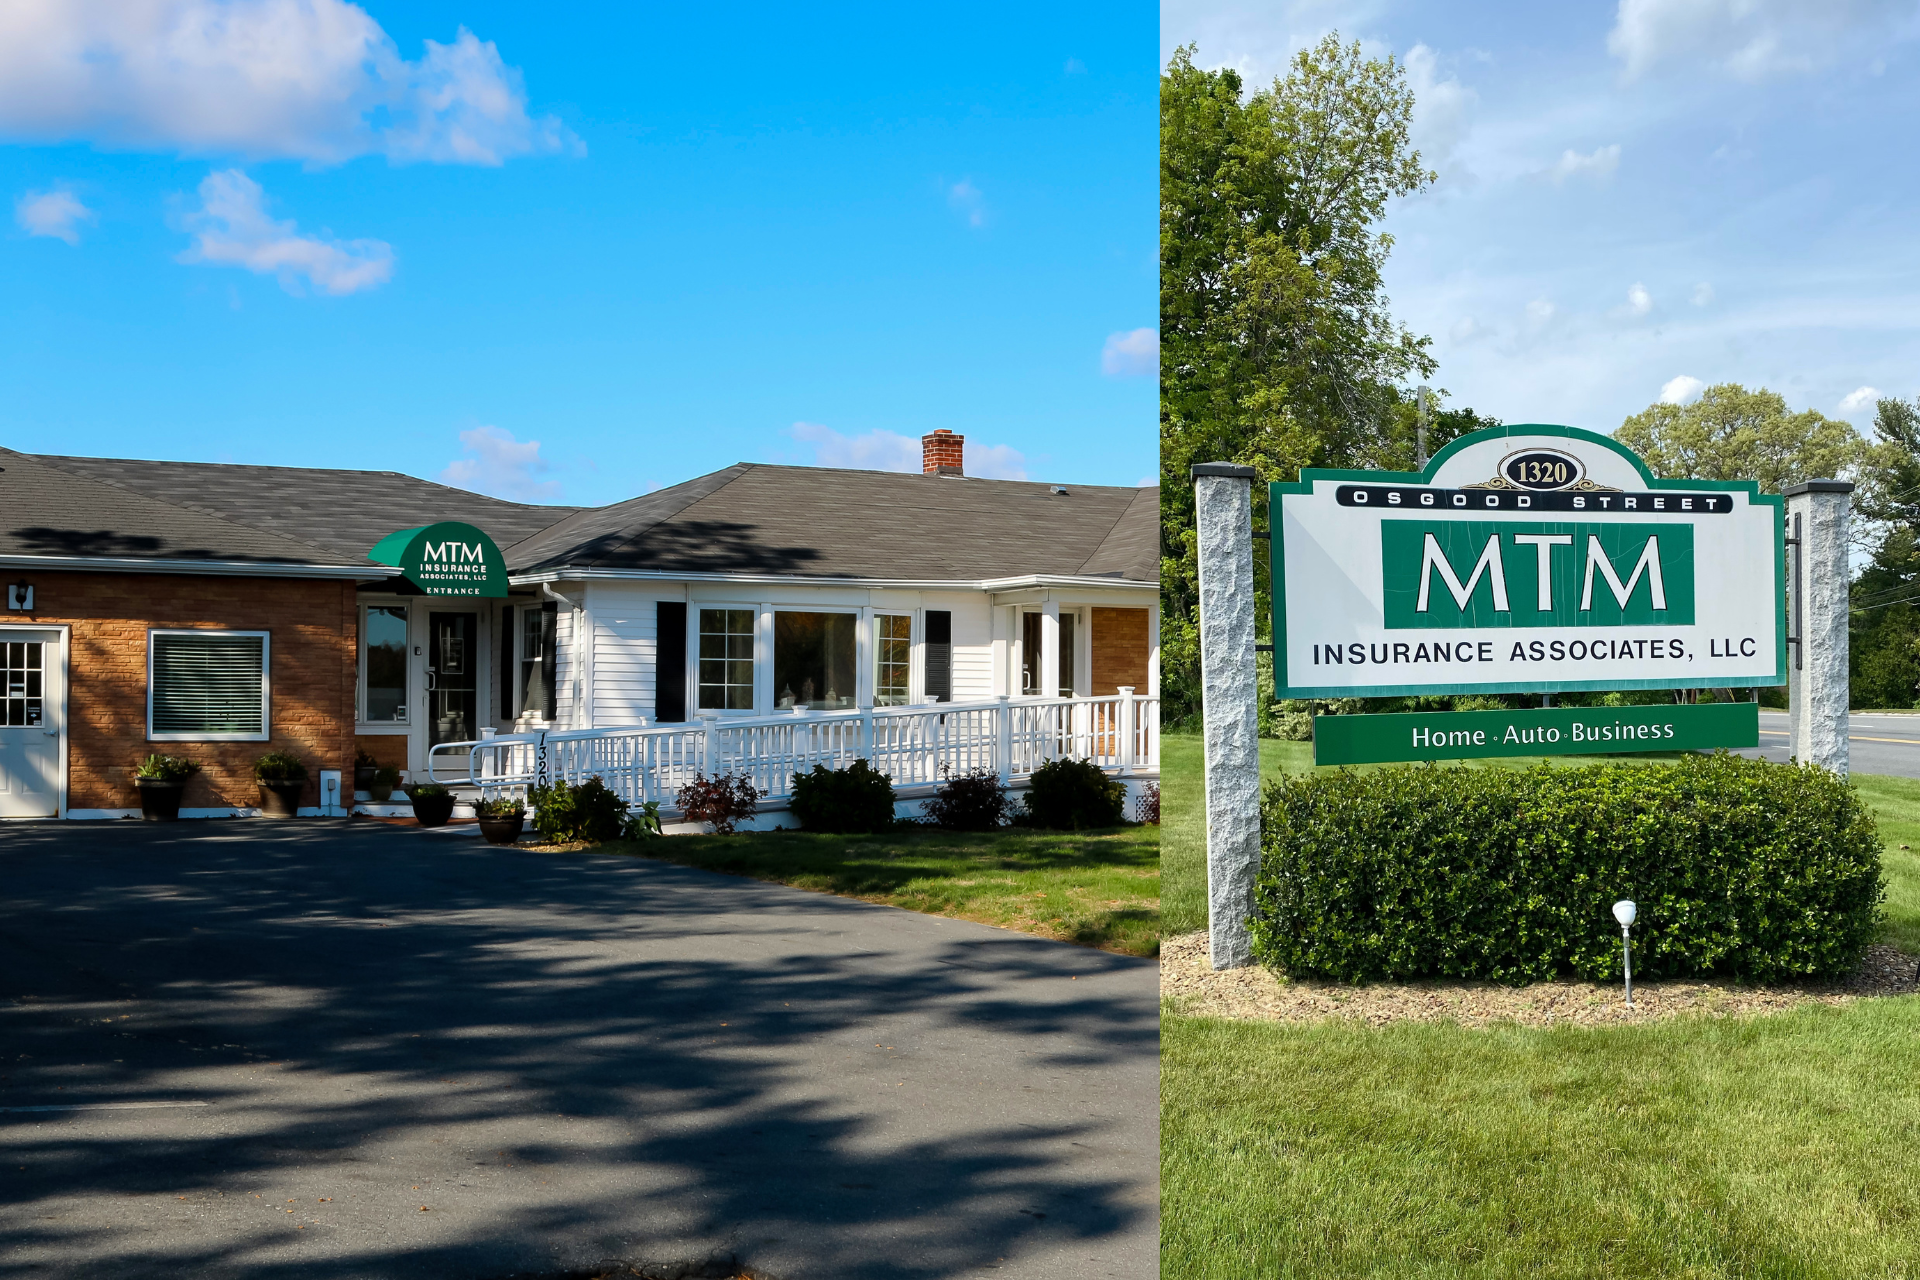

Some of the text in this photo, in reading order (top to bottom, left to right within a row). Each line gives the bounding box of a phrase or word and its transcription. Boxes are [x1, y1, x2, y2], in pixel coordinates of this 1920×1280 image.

[1517, 461, 1567, 483] 1320
[1353, 490, 1718, 511] OSGOOD STREET
[423, 541, 484, 563] MTM
[419, 573, 472, 581] ASSOCIATES,
[420, 563, 487, 573] INSURANCE
[1414, 531, 1668, 614] MTM
[426, 587, 480, 595] ENTRANCE
[1313, 637, 1757, 665] INSURANCE ASSOCIATES, LLC
[1412, 720, 1675, 748] Home Auto Business
